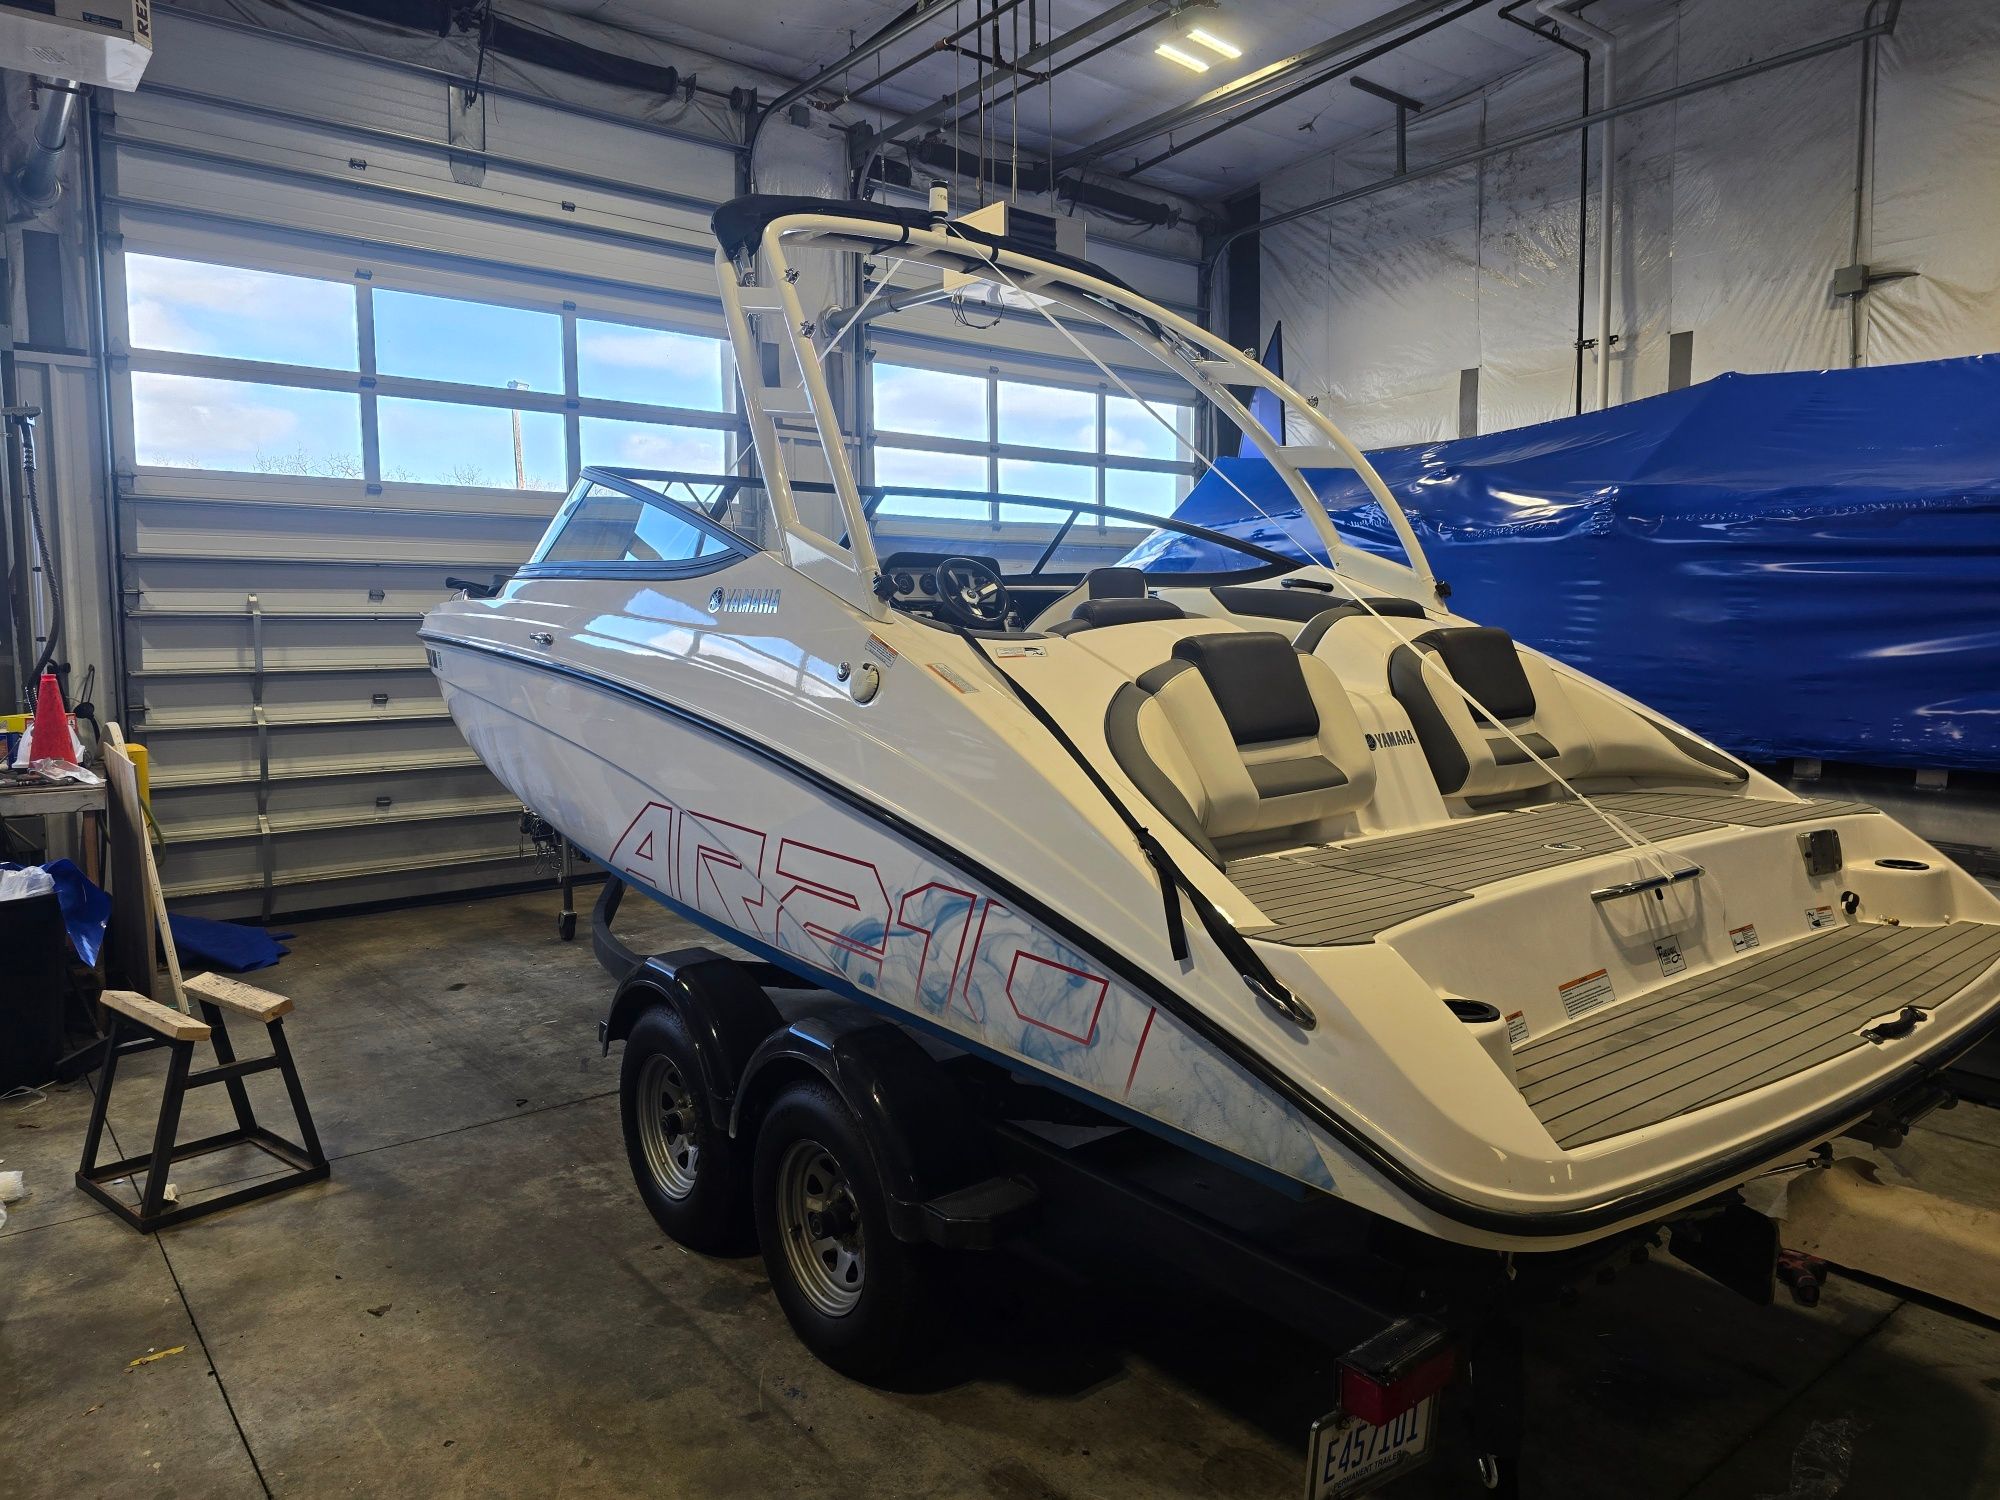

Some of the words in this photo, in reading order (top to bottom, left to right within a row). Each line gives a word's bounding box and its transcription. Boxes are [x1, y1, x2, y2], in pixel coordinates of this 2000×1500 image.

[724, 588, 781, 613] YAMAHA
[1374, 729, 1416, 749] YAMAHA
[1333, 1464, 1373, 1491] PERMANENT
[1375, 1450, 1402, 1468] TRAILER
